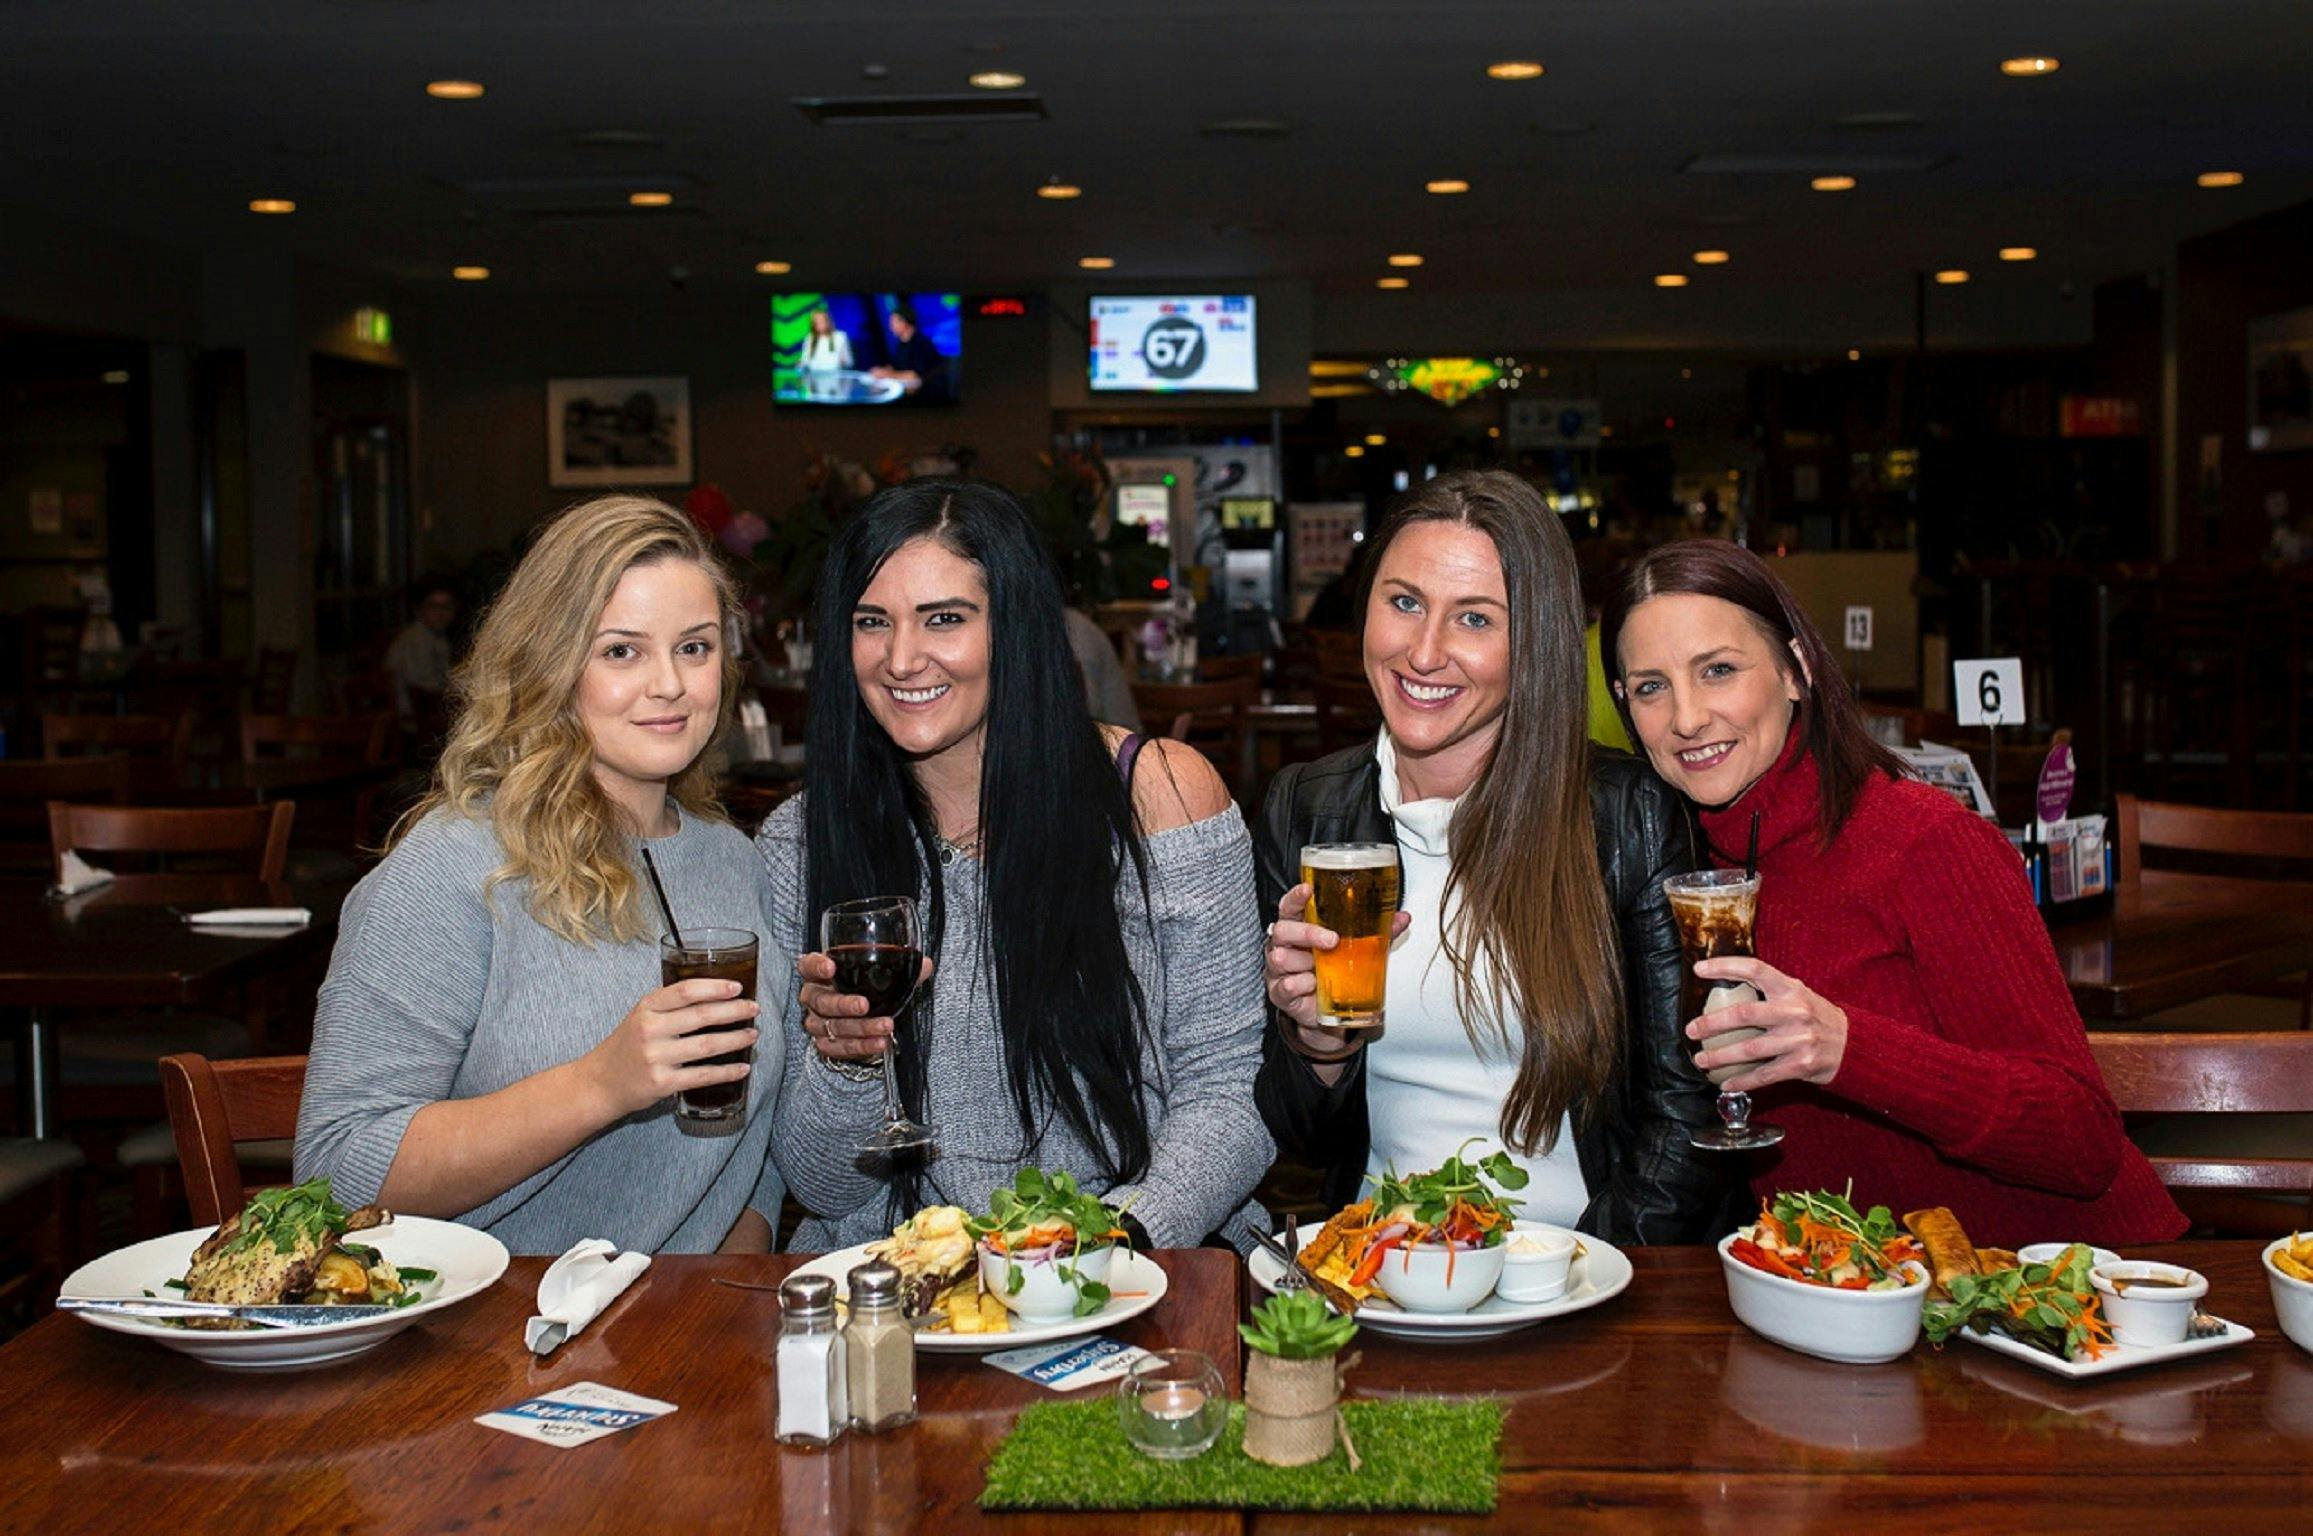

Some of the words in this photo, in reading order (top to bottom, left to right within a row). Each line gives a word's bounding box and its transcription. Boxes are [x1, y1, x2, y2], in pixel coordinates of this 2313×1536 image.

[1146, 328, 1199, 367] 67
[1850, 614, 1868, 641] 13
[1979, 670, 2001, 713] 6
